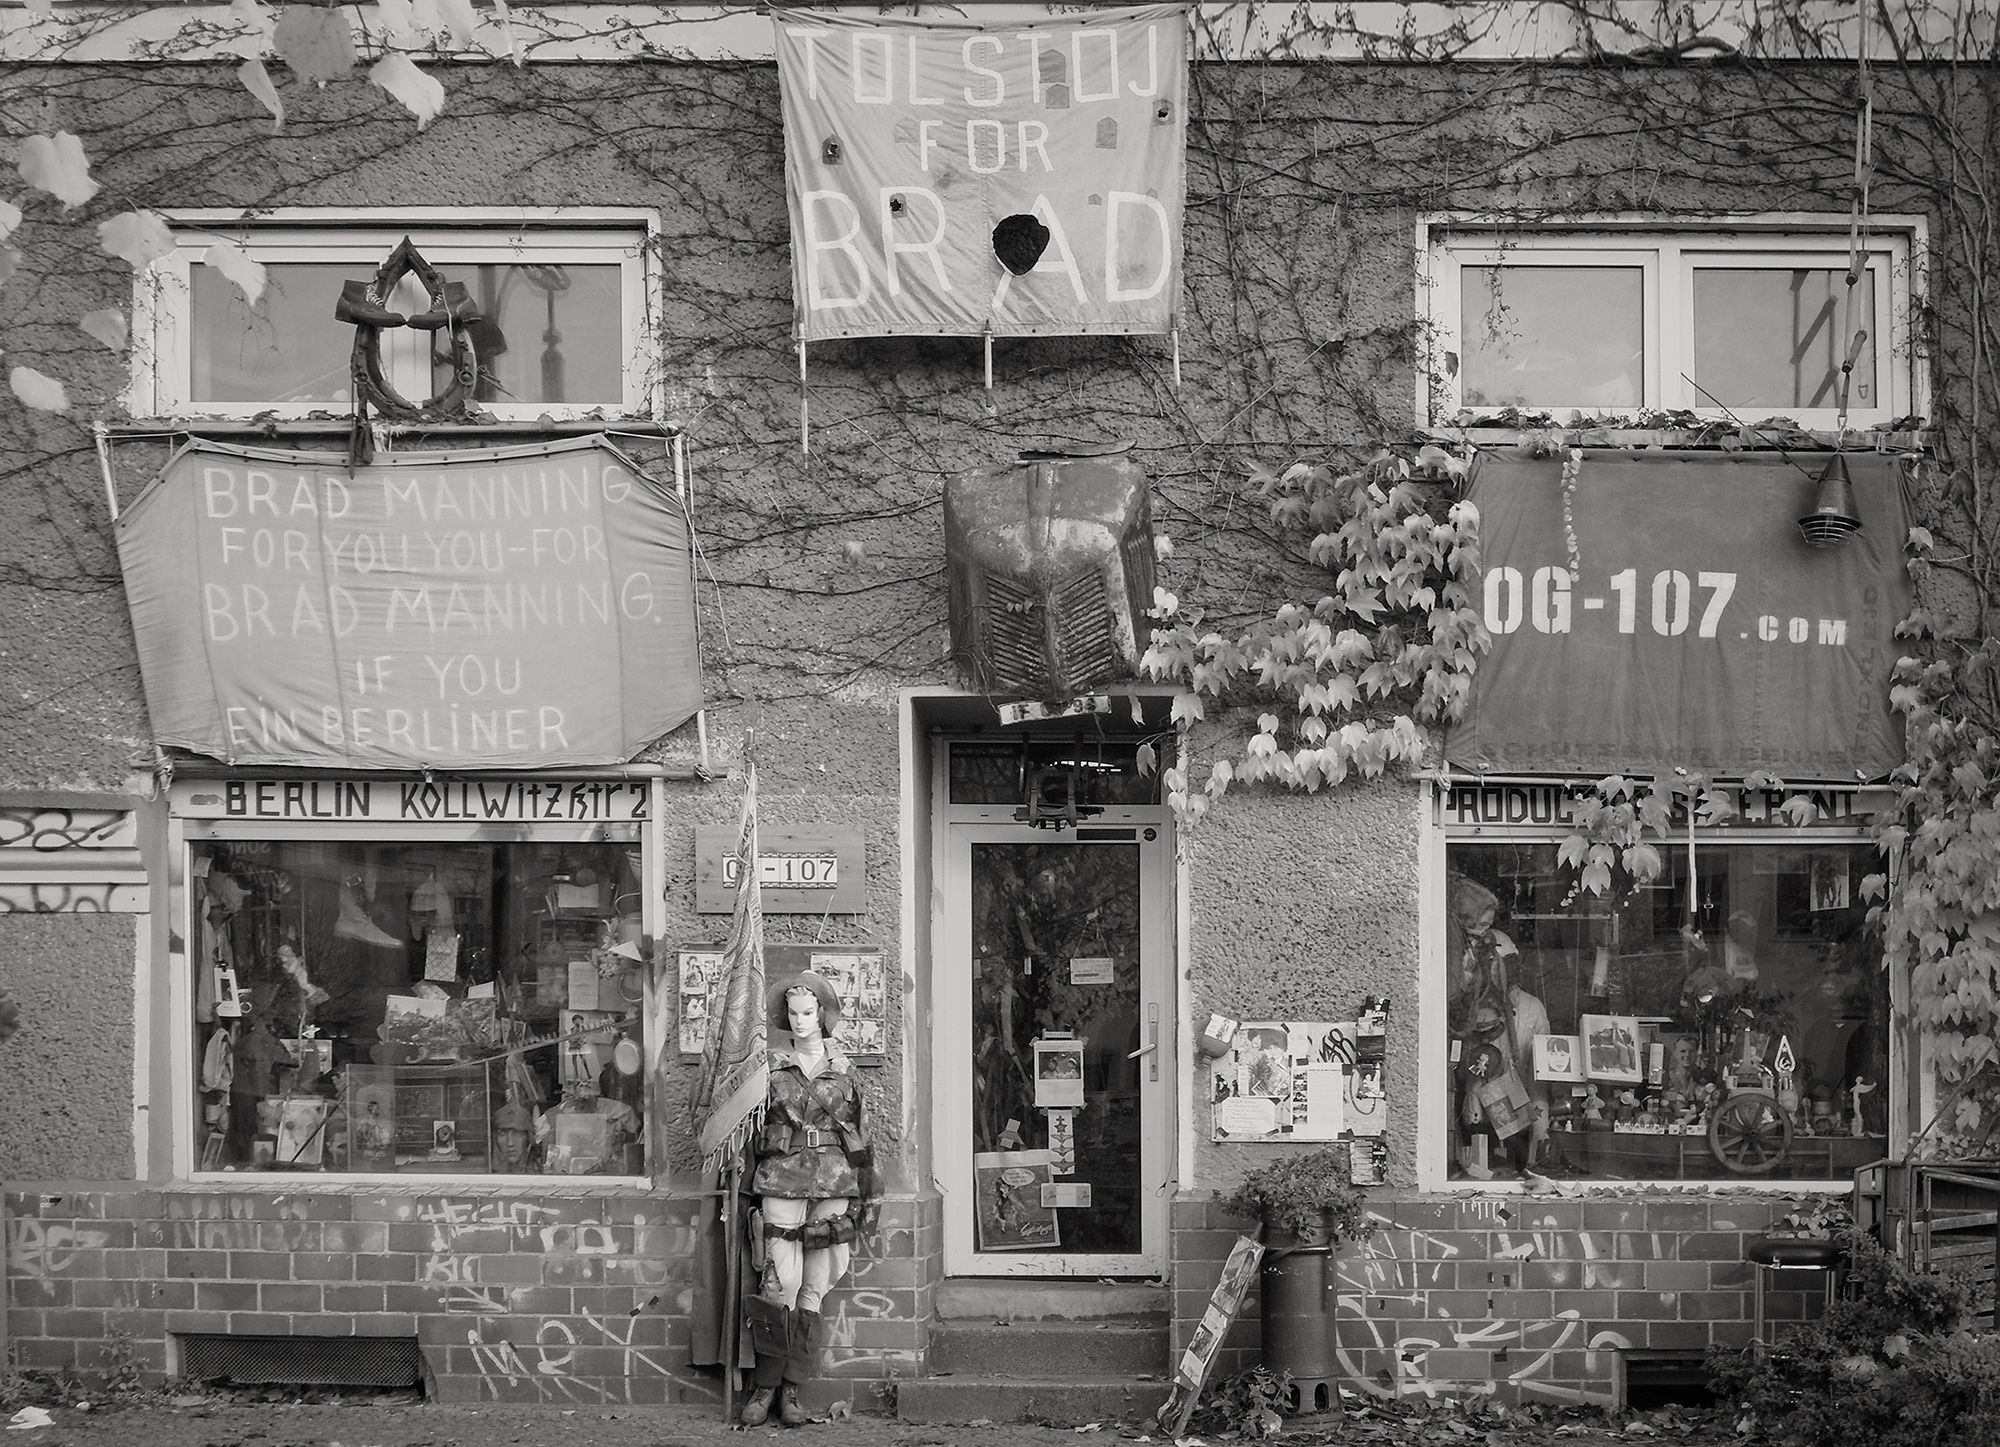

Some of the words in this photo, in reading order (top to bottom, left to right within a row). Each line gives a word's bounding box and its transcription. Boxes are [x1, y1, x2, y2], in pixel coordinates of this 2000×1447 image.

[786, 24, 1158, 108] TOLSTOJ
[919, 119, 1055, 174] FOR
[802, 186, 1172, 311] BRAD
[203, 467, 351, 520] BRAD
[382, 466, 633, 520] MANNING
[221, 526, 312, 573] FOR
[204, 582, 360, 642] BRAD
[385, 571, 662, 636] MANNING.
[356, 654, 394, 696] IF
[424, 654, 521, 700] YOU
[629, 783, 647, 819] 2
